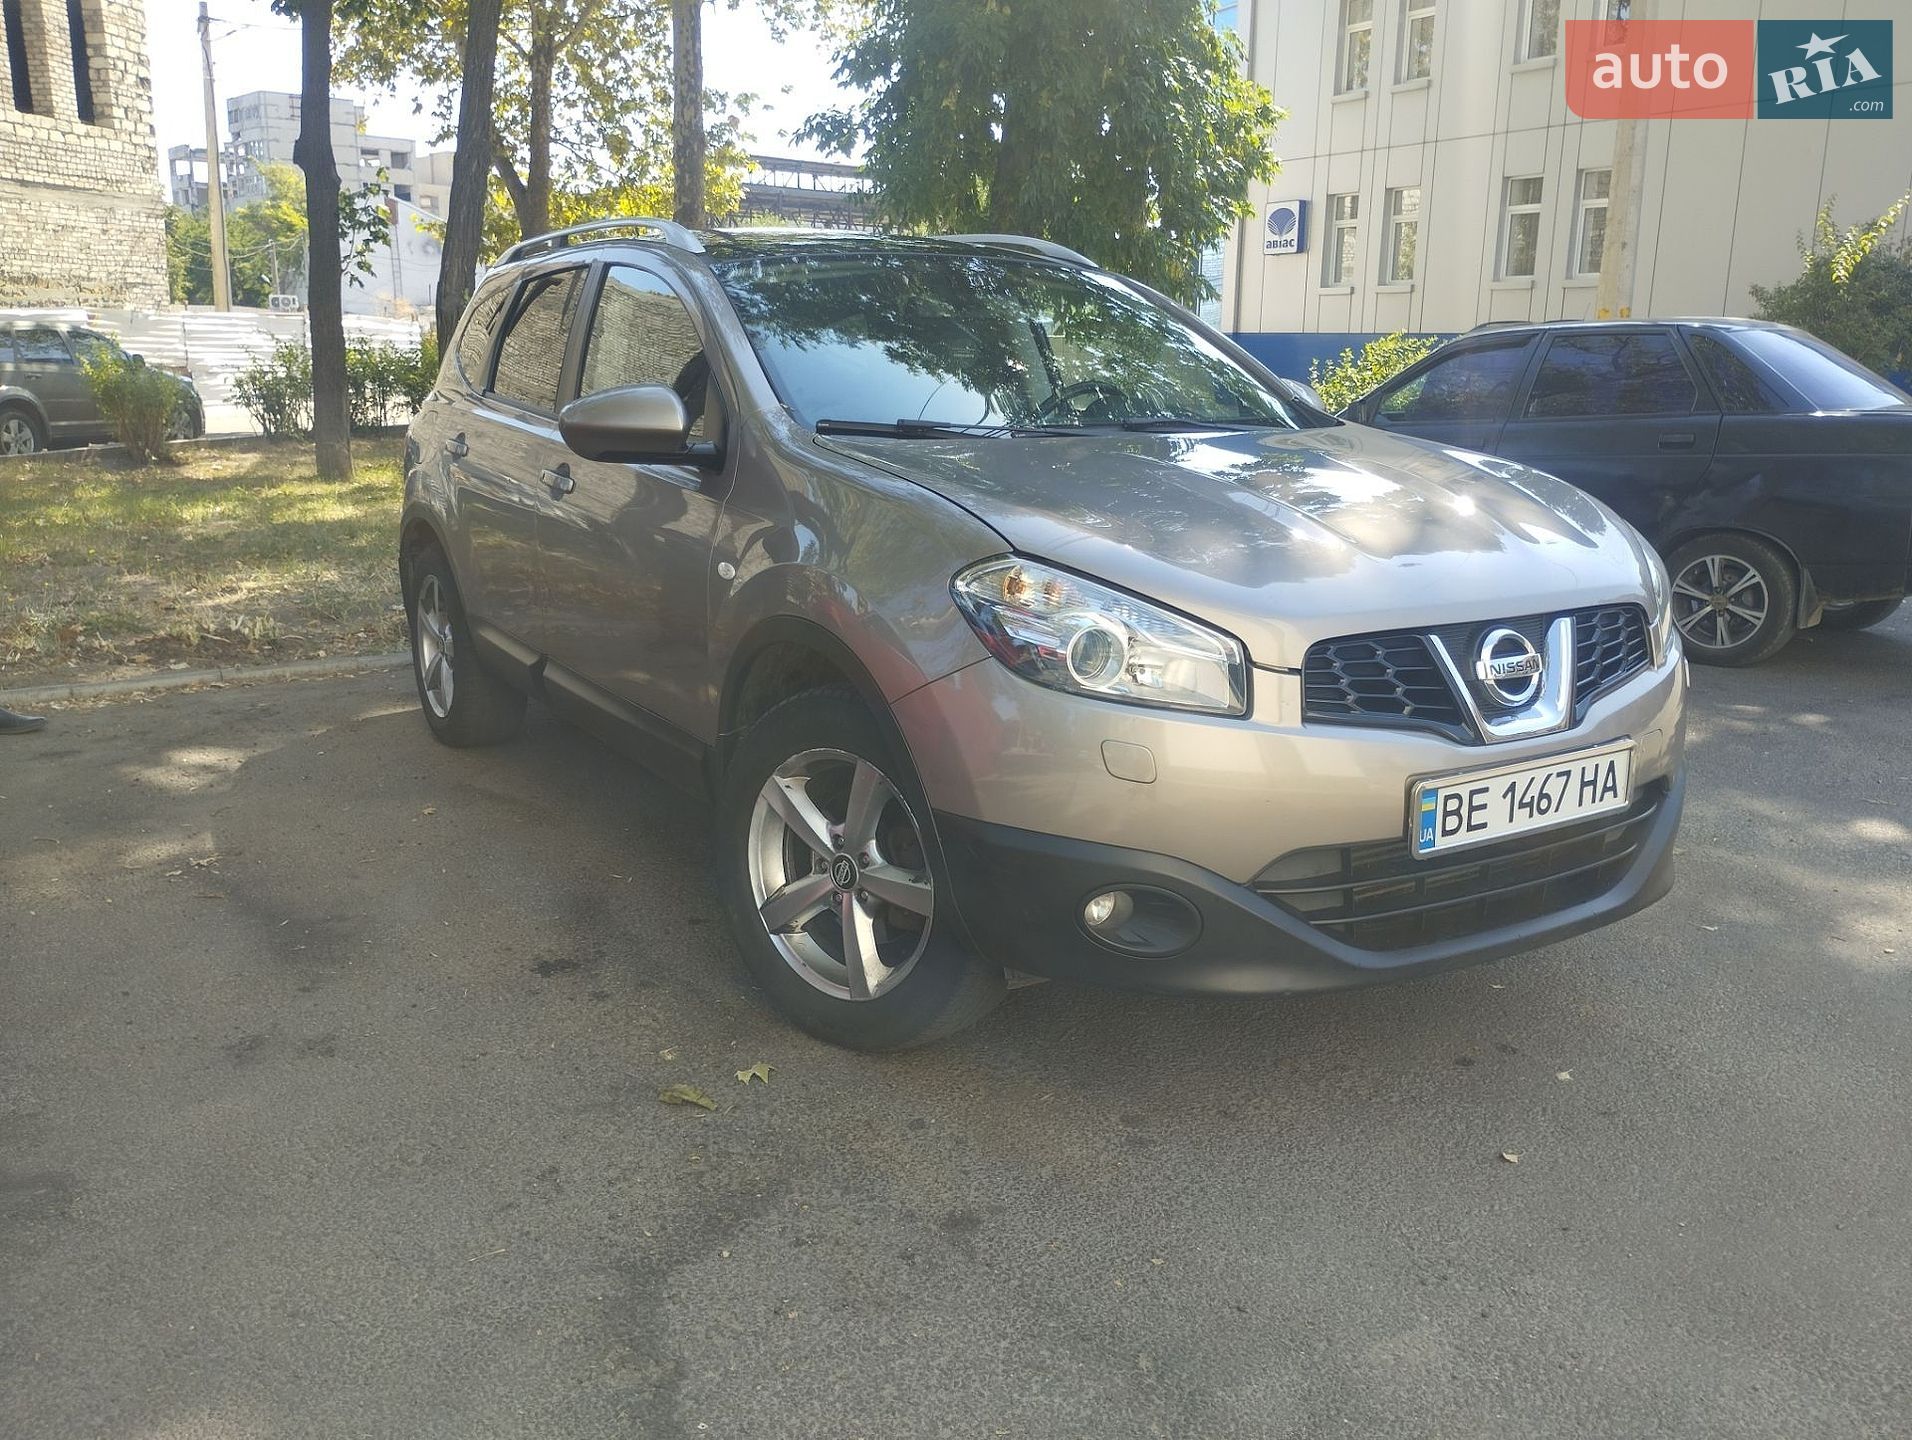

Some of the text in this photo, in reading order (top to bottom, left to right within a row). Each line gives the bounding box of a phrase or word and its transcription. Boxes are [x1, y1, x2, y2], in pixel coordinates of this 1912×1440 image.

[1490, 659, 1539, 675] NISSAN
[1441, 759, 1618, 837] BE 1467 HA
[1419, 827, 1434, 843] UA
